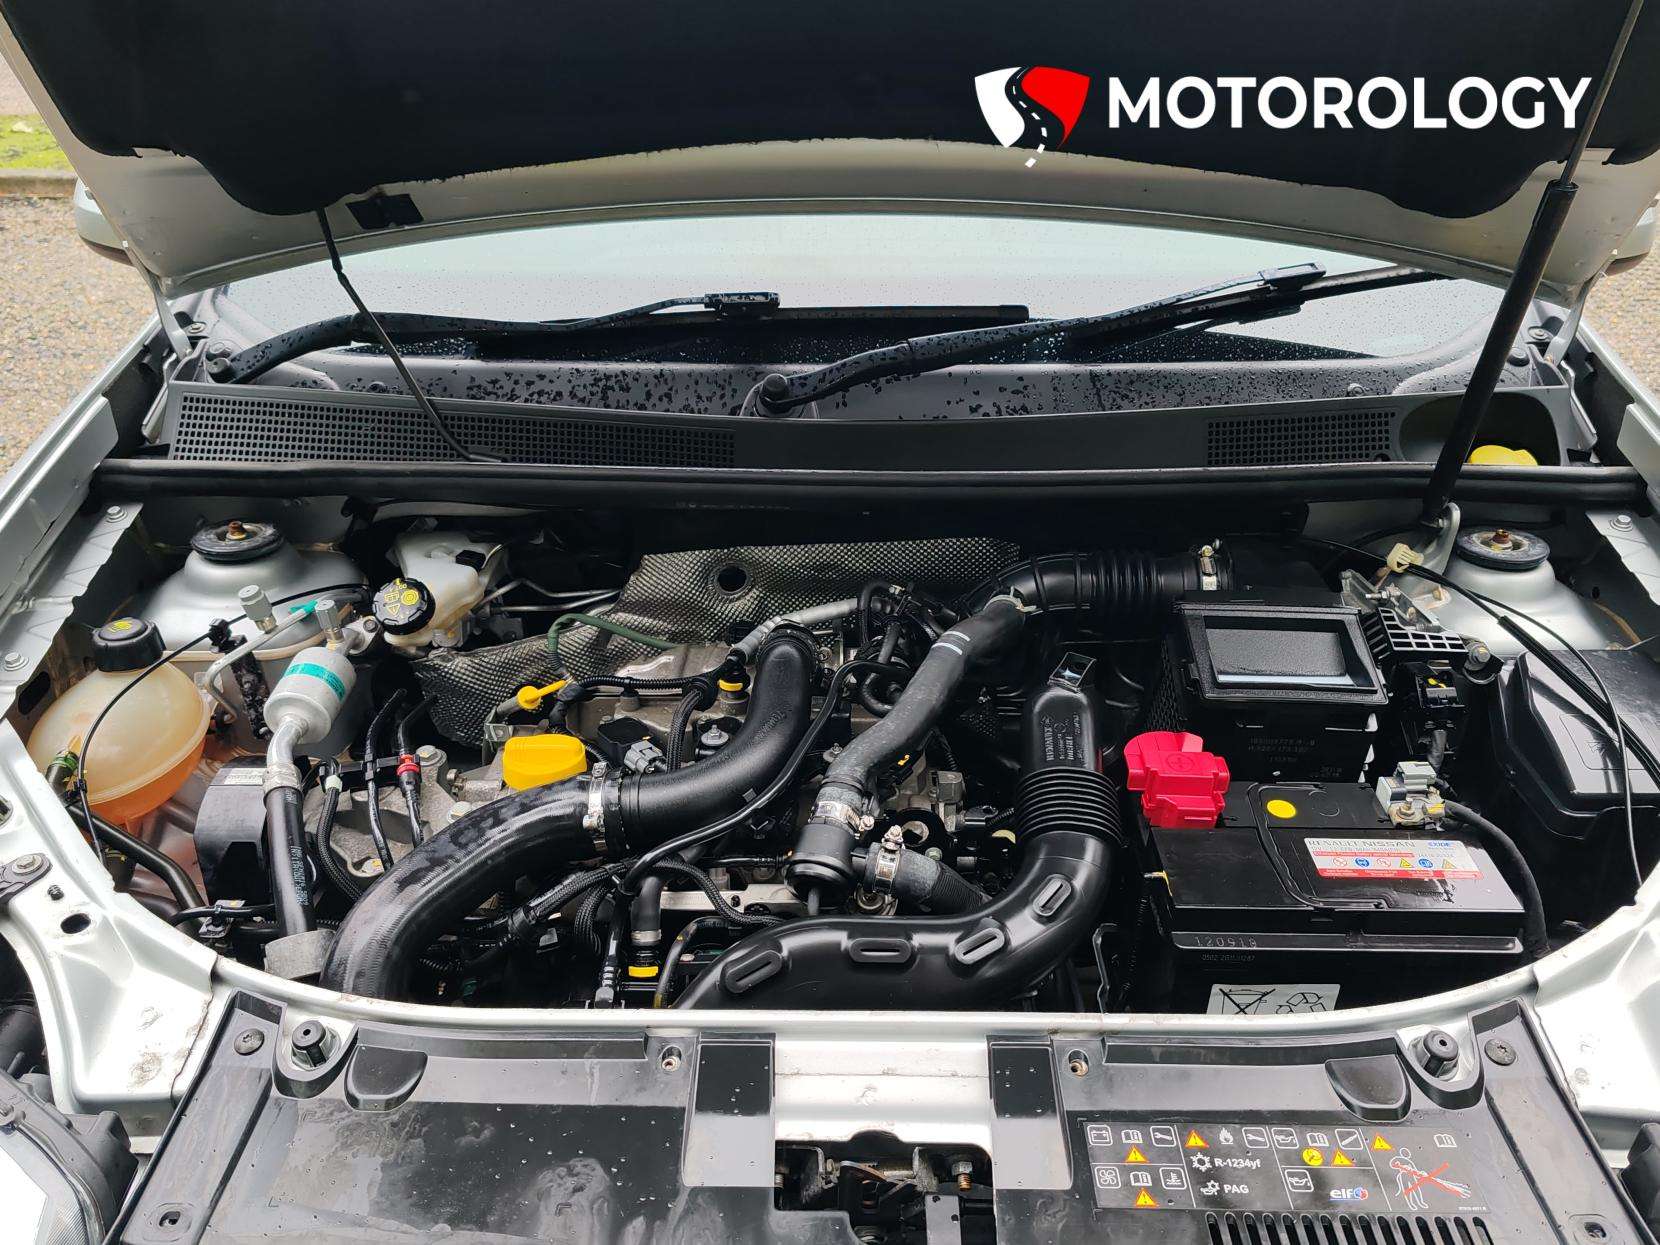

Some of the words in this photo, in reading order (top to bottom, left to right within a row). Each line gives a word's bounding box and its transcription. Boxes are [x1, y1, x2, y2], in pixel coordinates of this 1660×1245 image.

[1214, 1157, 1261, 1169] R-1234yf
[1223, 1184, 1250, 1194] PAG
[1330, 1188, 1354, 1199] elf
